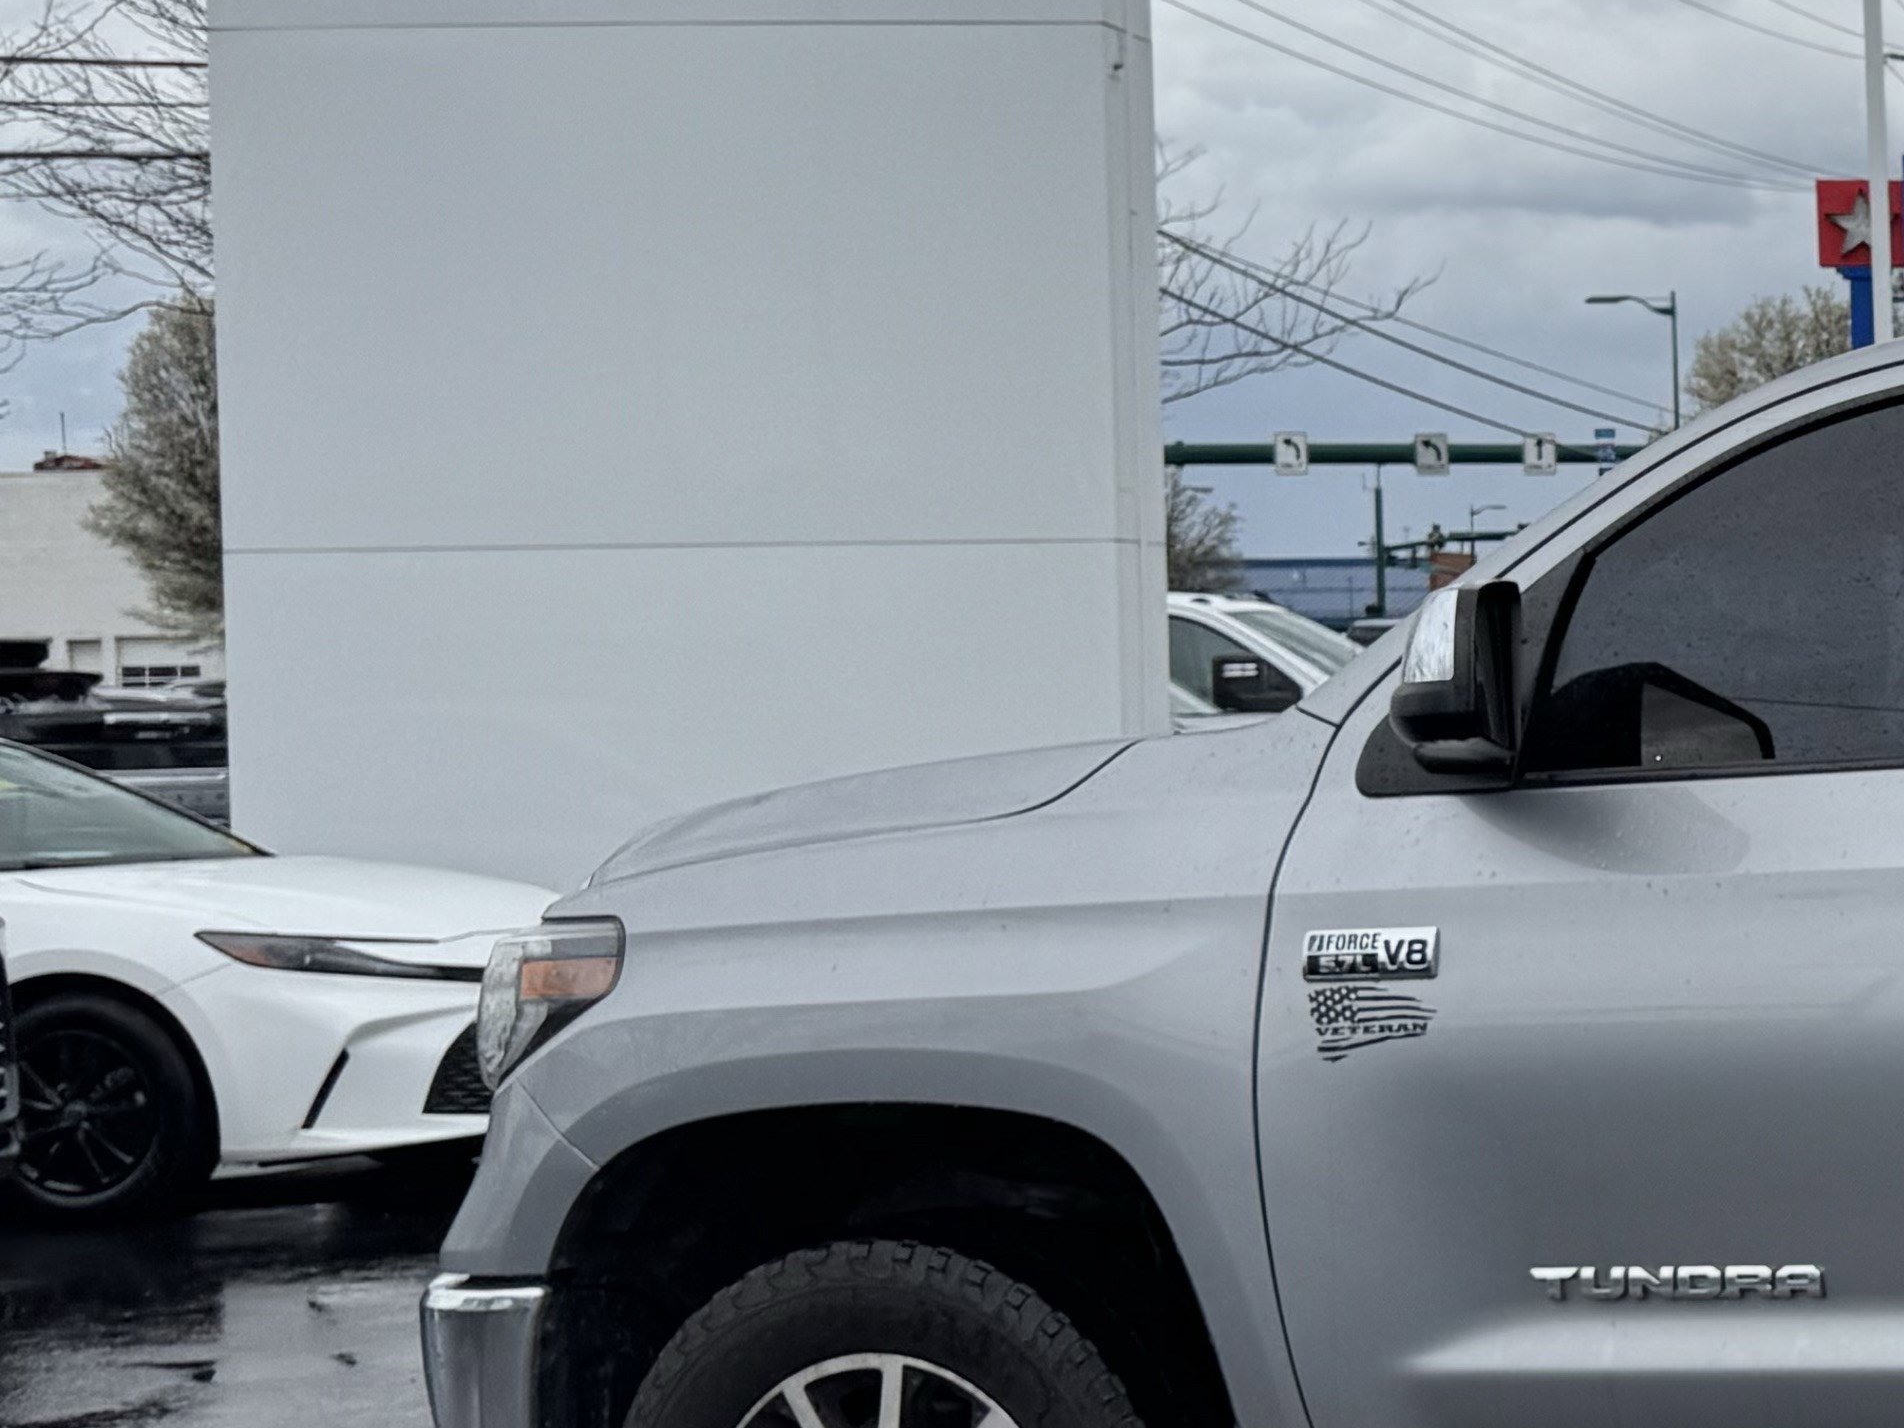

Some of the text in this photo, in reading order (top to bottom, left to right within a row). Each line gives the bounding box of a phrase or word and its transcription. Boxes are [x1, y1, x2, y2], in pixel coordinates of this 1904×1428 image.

[1383, 938, 1428, 970] V8
[1315, 1022, 1428, 1037] VETERAN
[1530, 1264, 1826, 1299] TUNDRA
